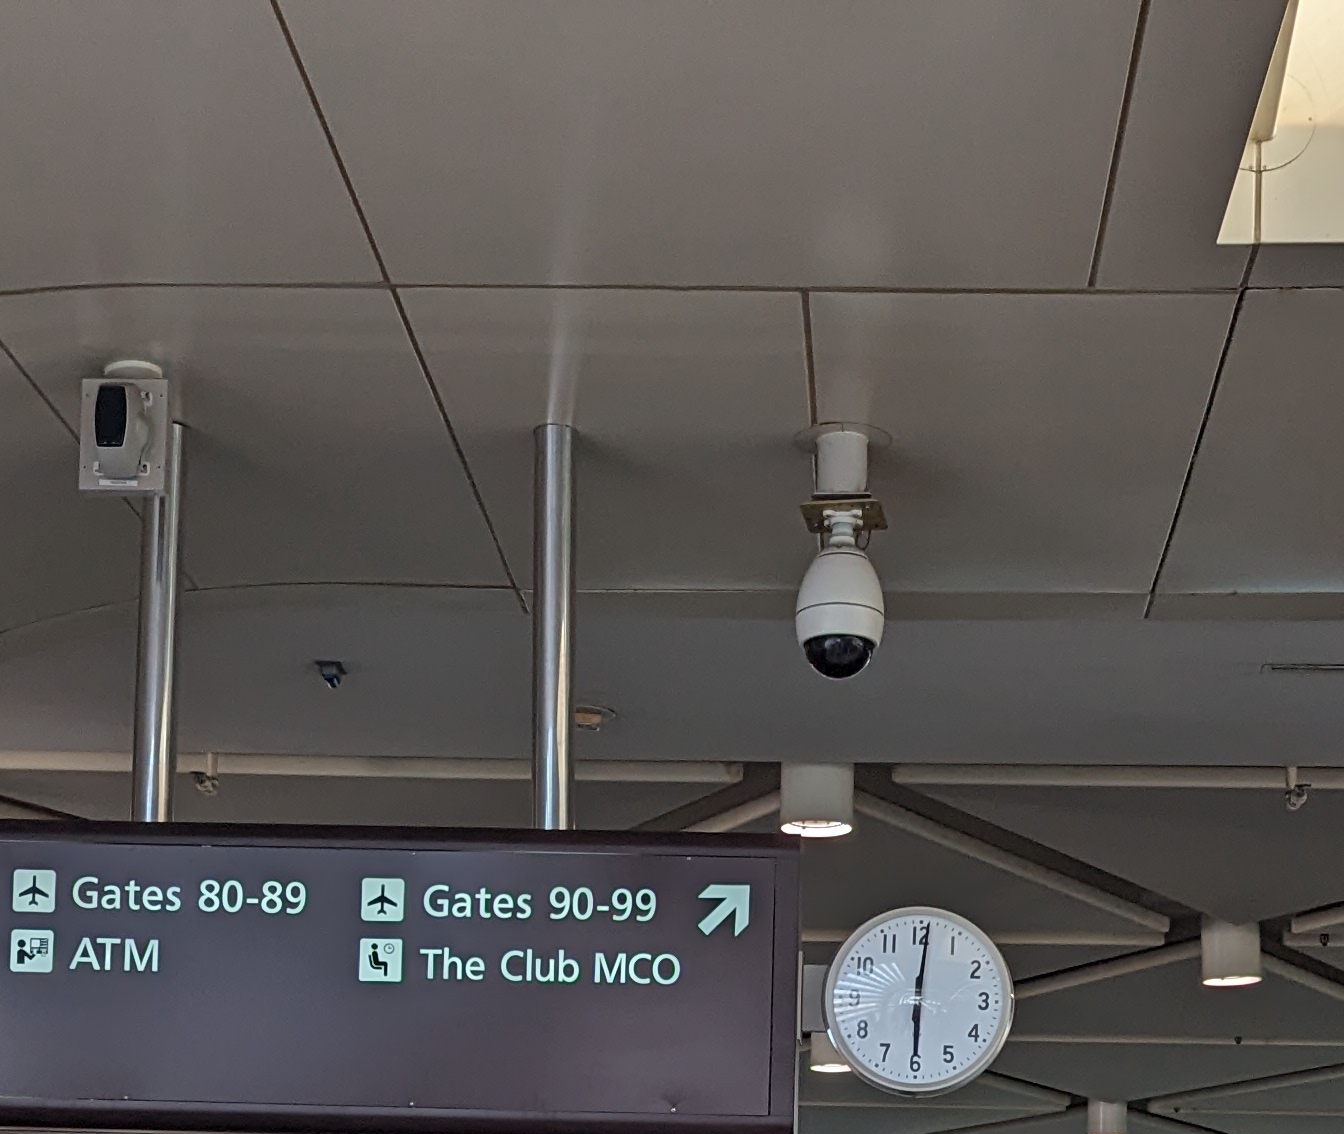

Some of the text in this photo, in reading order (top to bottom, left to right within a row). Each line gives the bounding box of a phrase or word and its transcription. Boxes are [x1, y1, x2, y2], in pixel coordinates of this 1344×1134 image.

[72, 876, 306, 915] Gates 80-89
[423, 884, 657, 922] Gates 90-99
[882, 933, 896, 954] 11
[912, 925, 930, 946] 12
[950, 935, 956, 956] 1
[69, 937, 159, 972] ATM
[419, 946, 681, 985] The Club MCO
[856, 956, 874, 976] 10
[970, 960, 981, 980] 2
[848, 989, 861, 1007] 9
[977, 991, 990, 1011] 3
[856, 1020, 869, 1039] 8
[967, 1023, 980, 1043] 4
[879, 1042, 891, 1063] 7
[942, 1044, 955, 1064] 5
[909, 1053, 921, 1073] 6
